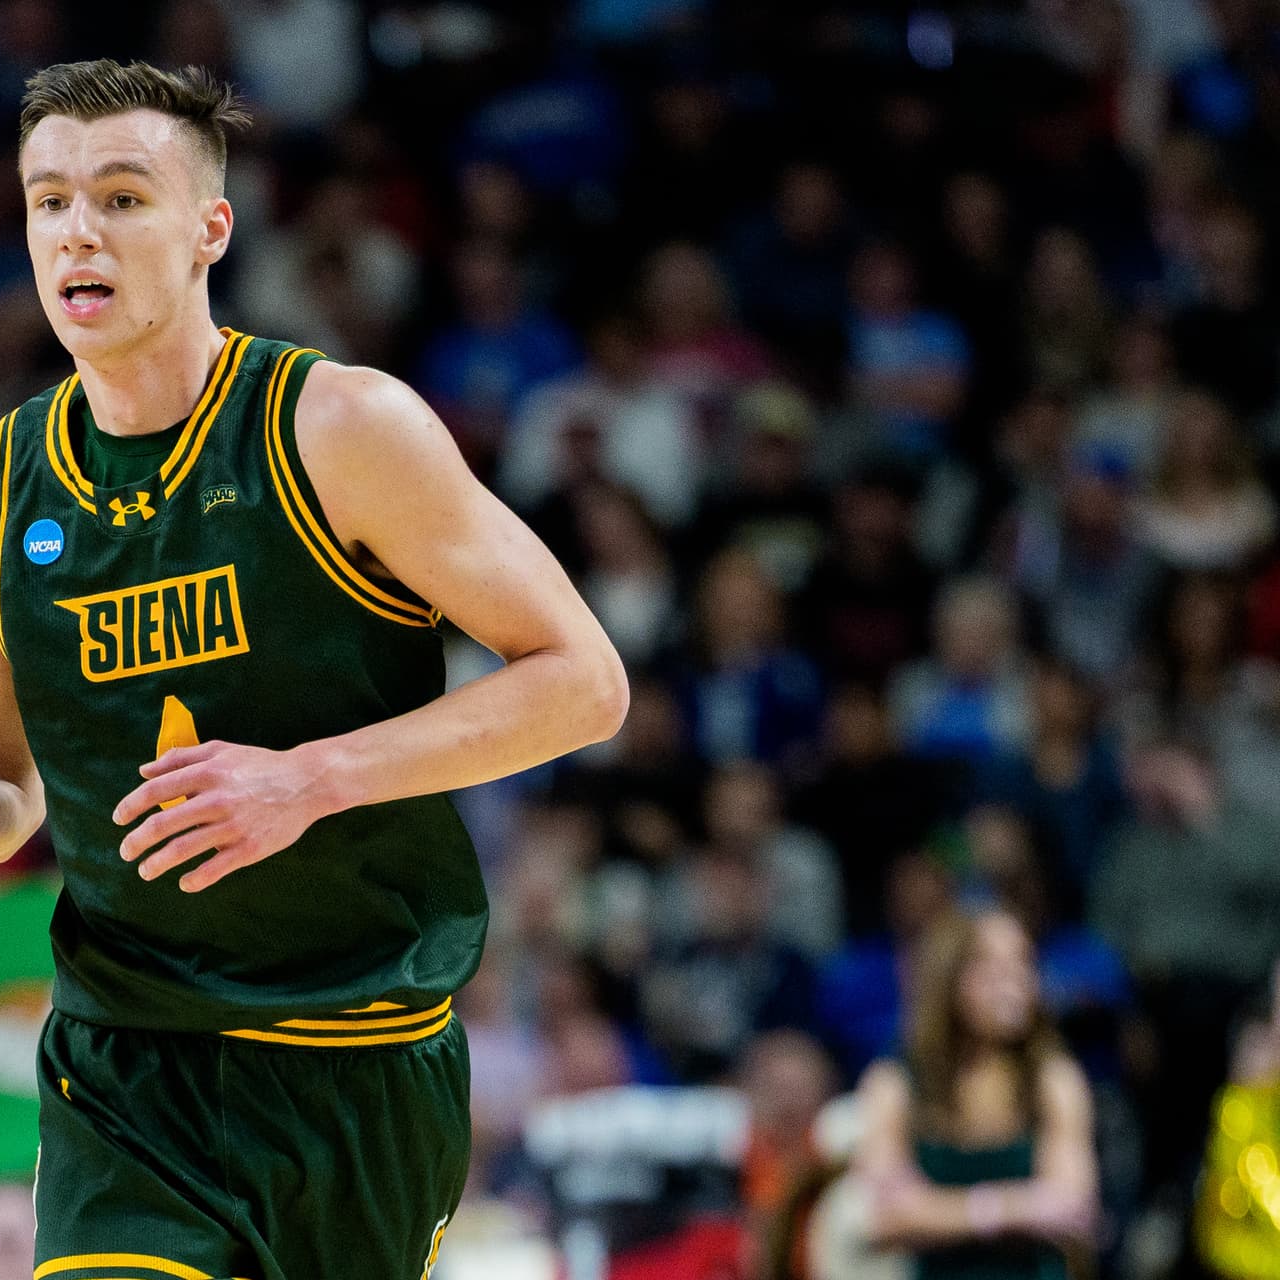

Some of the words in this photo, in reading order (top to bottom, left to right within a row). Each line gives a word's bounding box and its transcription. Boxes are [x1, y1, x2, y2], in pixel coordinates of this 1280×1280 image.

[201, 485, 236, 514] MAAC
[28, 539, 62, 554] NCAA
[79, 573, 240, 675] SIENA
